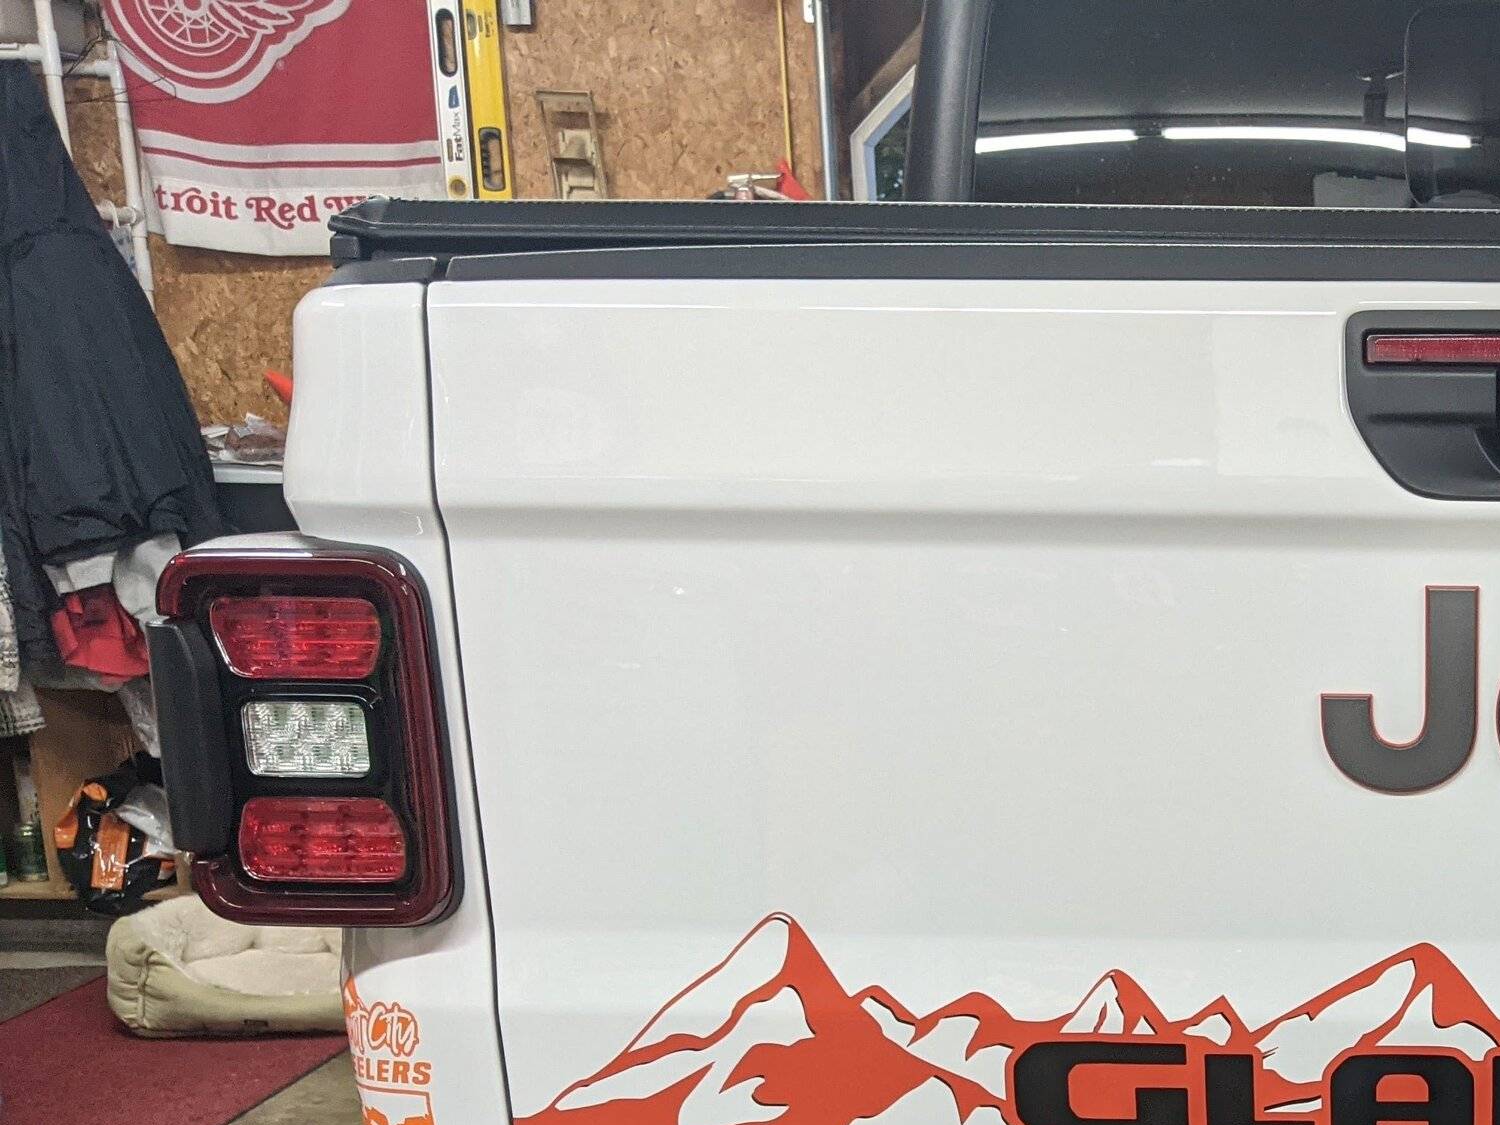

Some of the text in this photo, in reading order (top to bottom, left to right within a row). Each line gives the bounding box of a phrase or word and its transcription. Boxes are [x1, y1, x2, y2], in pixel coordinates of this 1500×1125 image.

[155, 184, 238, 221] troit
[245, 195, 320, 230] Red
[352, 1055, 432, 1085] ELERS
